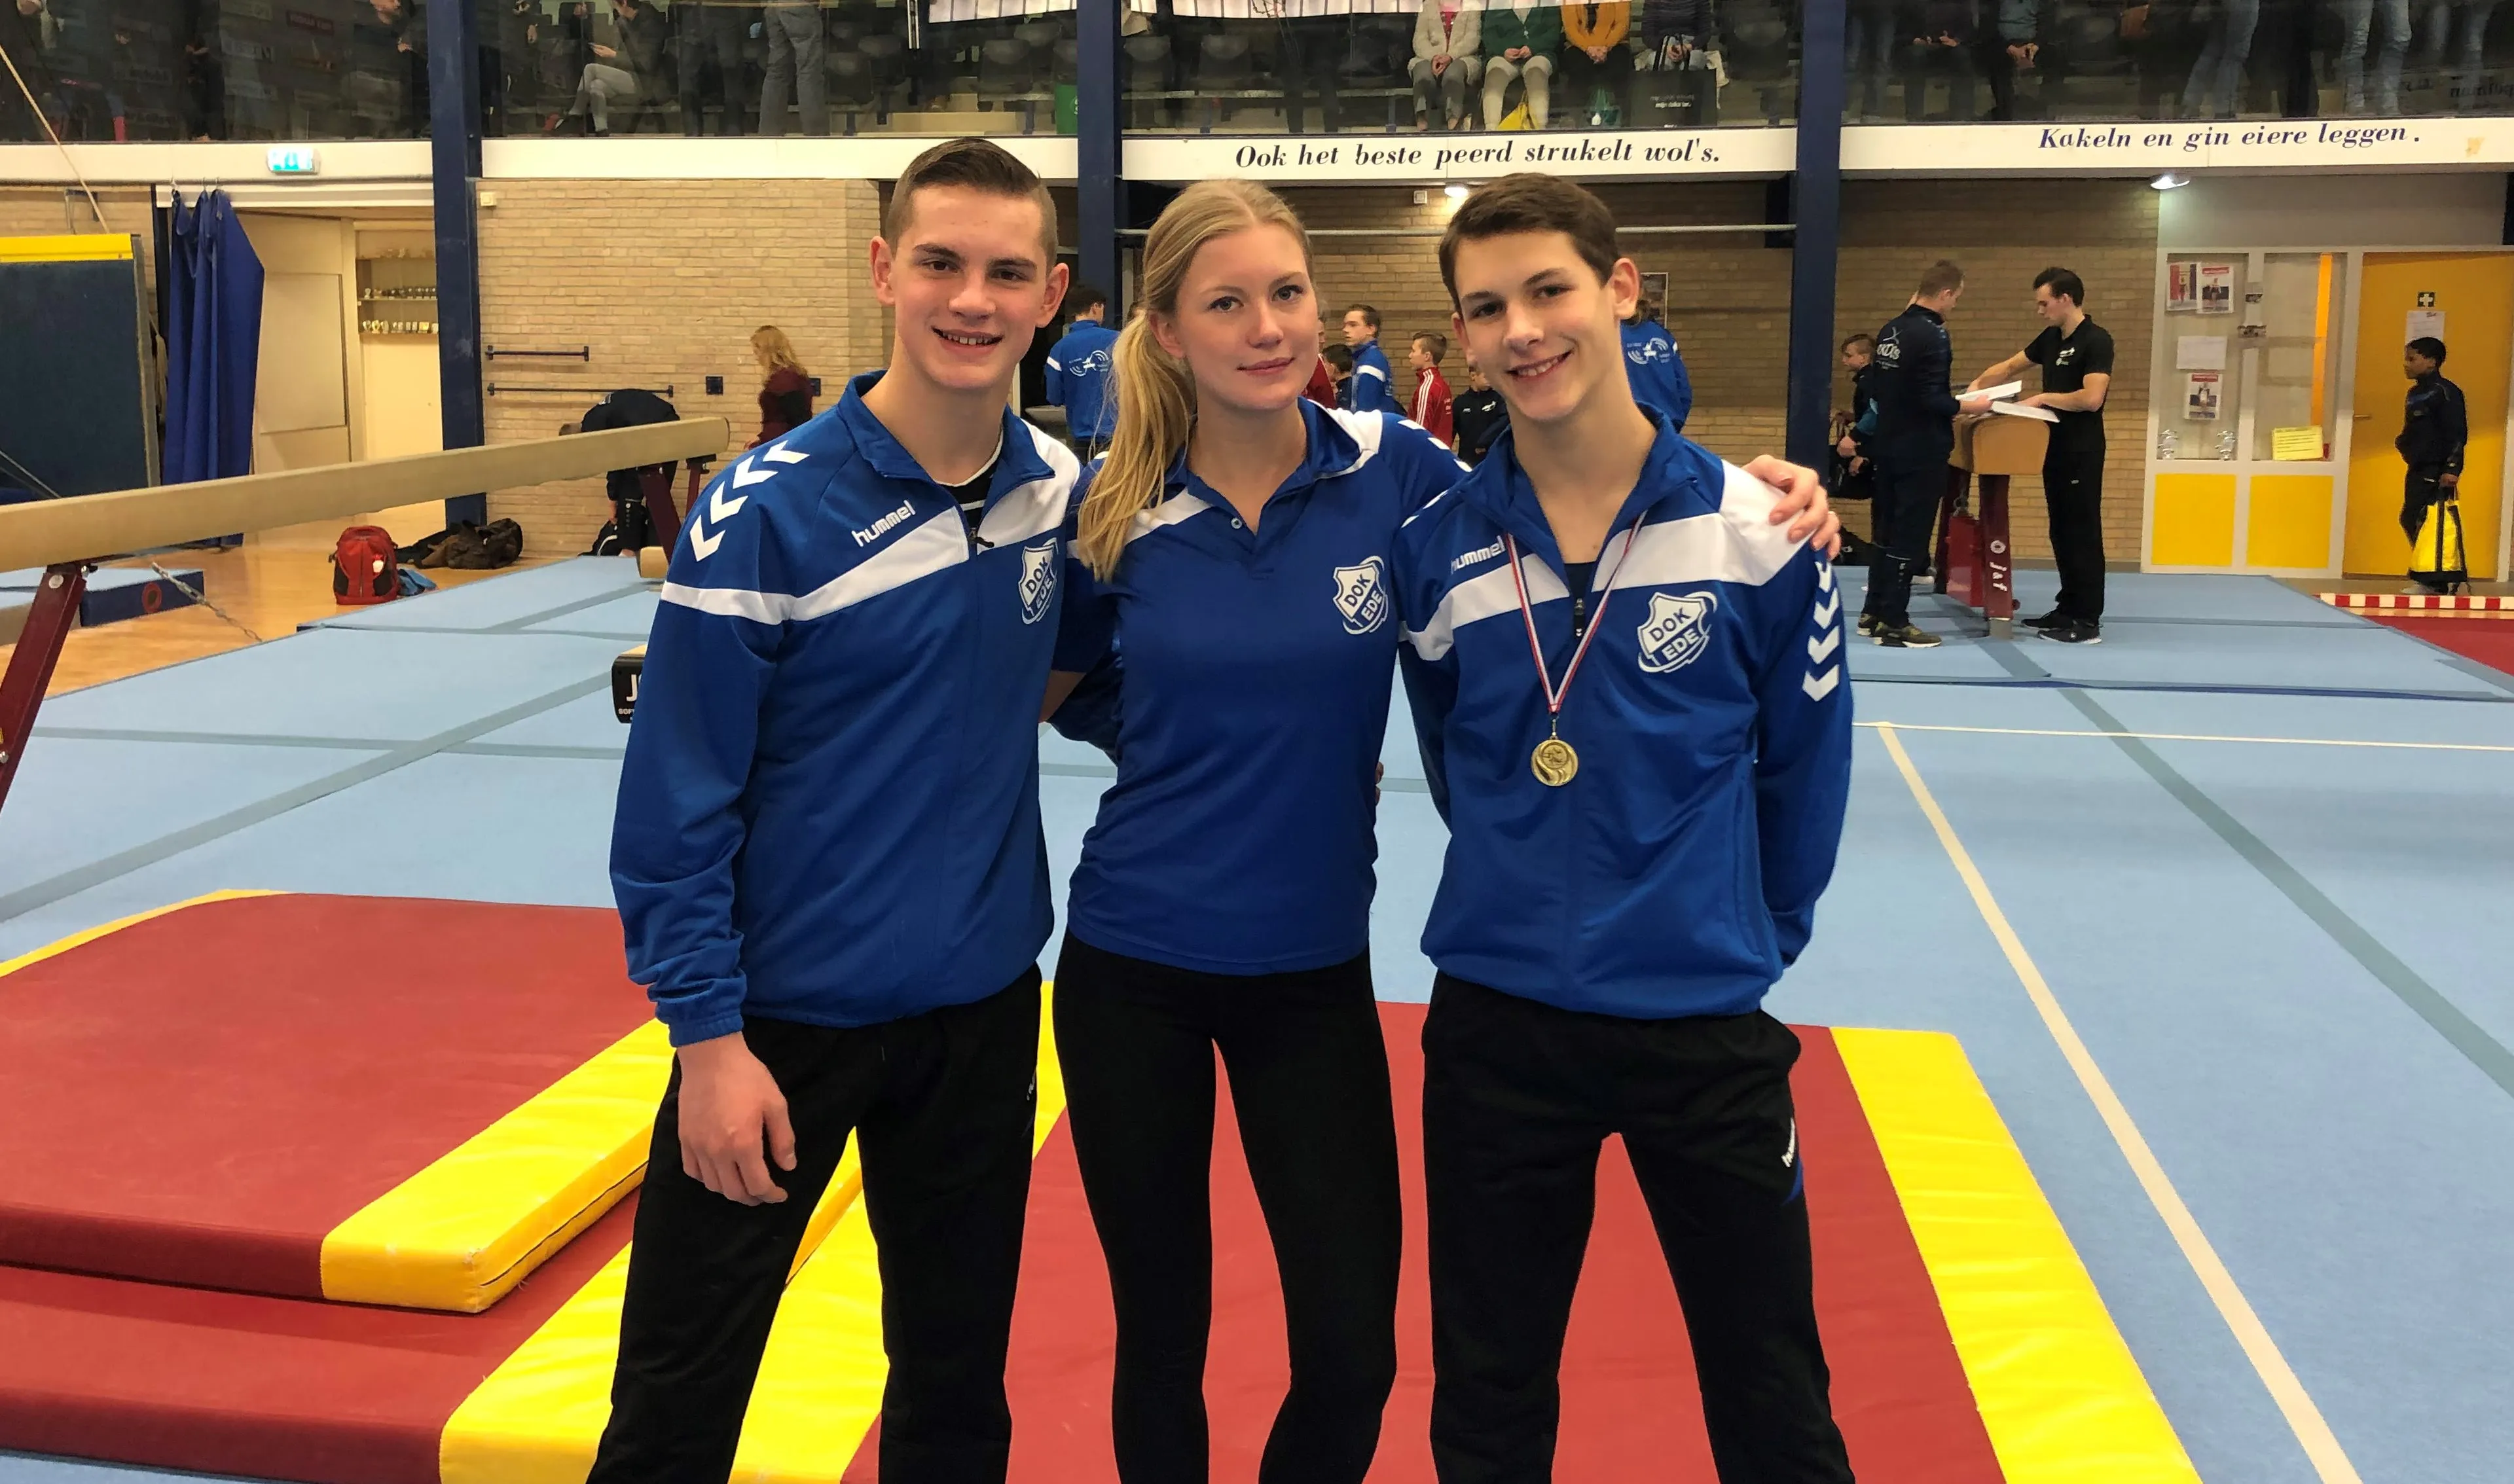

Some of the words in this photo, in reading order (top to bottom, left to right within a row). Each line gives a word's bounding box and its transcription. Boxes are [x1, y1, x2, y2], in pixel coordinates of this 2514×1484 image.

[1235, 144, 1287, 168] Ook
[1298, 143, 1339, 165] het
[1355, 143, 1422, 166] beste
[1433, 139, 1514, 170] peerd
[1524, 138, 1633, 162] strukelt
[1644, 137, 1720, 162] wol's.
[2038, 128, 2131, 148] Kakeln
[2143, 133, 2174, 147] en
[2183, 126, 2231, 153] gin
[2242, 125, 2308, 145] eiere
[851, 499, 916, 547] hummel
[1025, 555, 1048, 595] DOK
[1036, 574, 1053, 609] EDE
[1343, 573, 1371, 607] DOK
[1361, 590, 1383, 621] EDE
[1648, 607, 1692, 642] DOK
[1662, 628, 1700, 661] EDE
